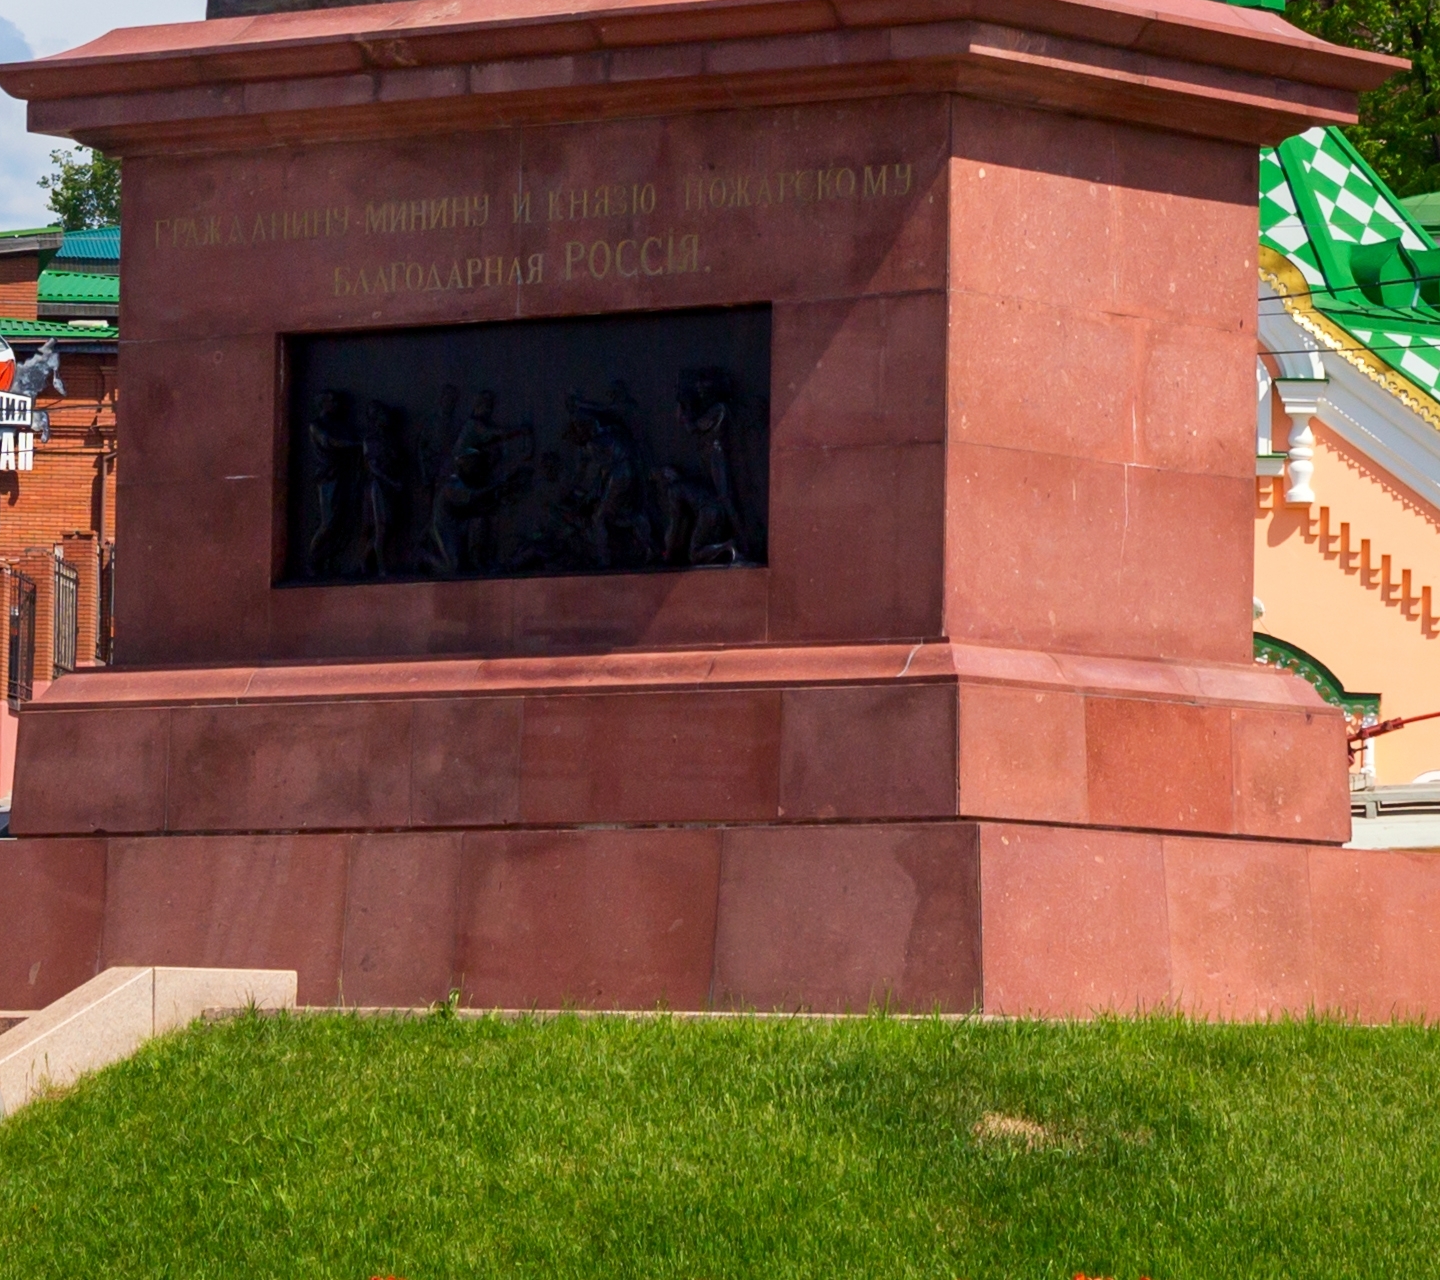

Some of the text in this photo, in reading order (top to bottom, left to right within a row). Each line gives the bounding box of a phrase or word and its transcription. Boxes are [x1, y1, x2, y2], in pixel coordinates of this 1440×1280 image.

[365, 194, 490, 235] МИНИНУ
[512, 192, 532, 224] И
[547, 183, 656, 222] КНЯЗЮ
[684, 163, 913, 211] ПОЖАРСКОМУ
[333, 253, 545, 297] БЛАГОДАРНАЯ
